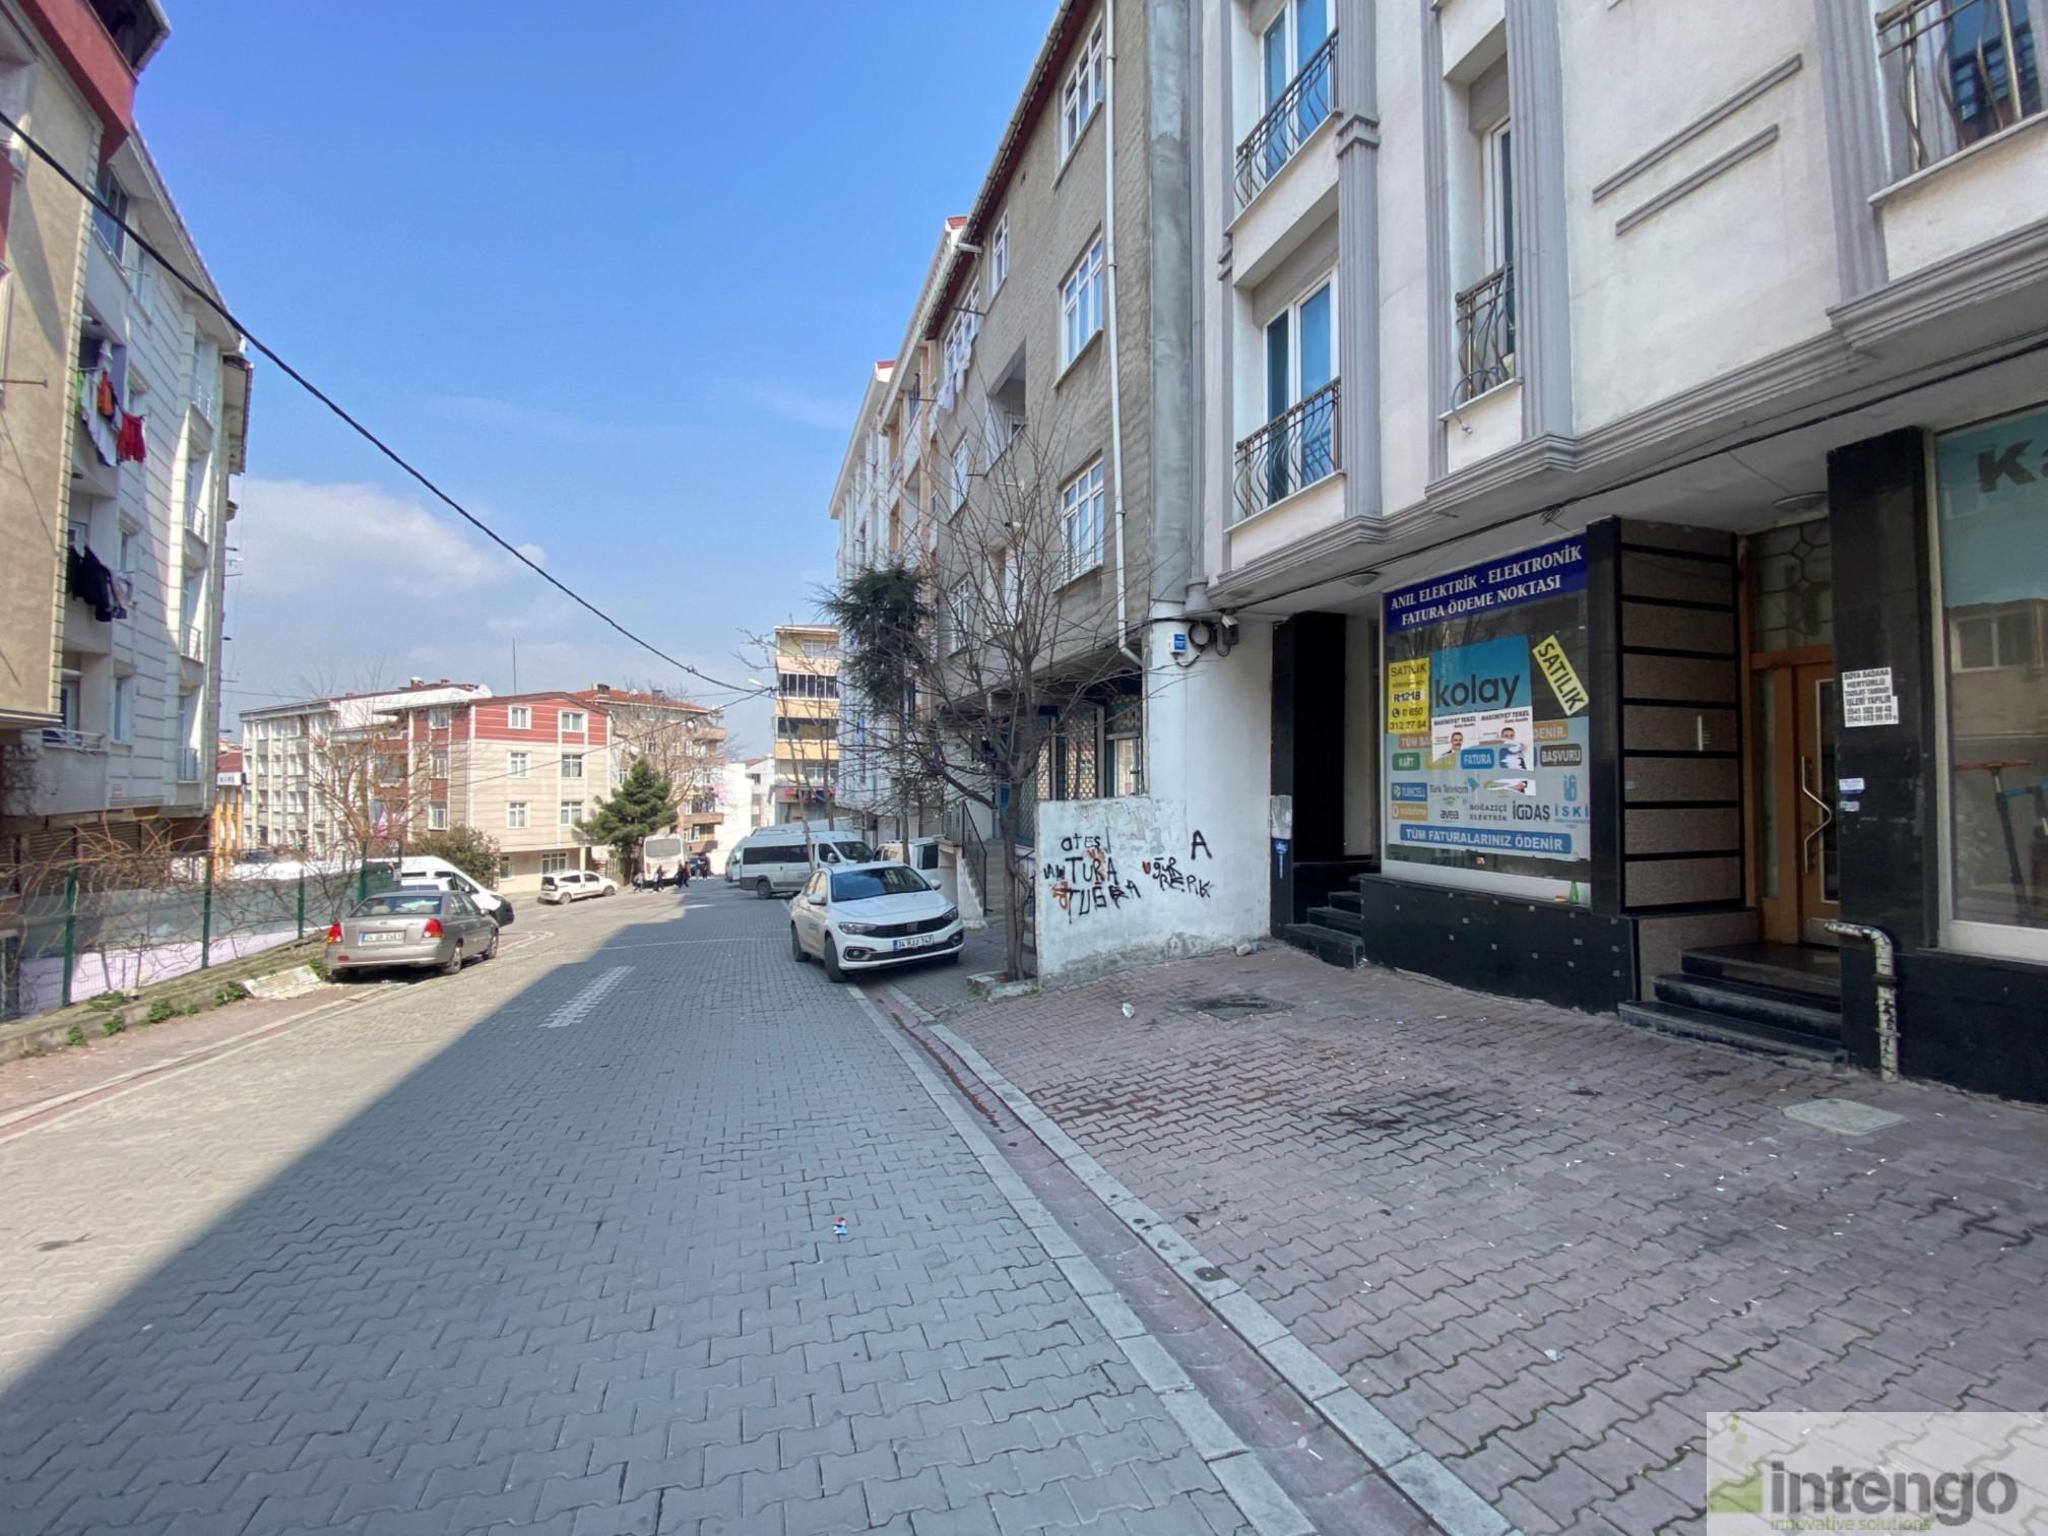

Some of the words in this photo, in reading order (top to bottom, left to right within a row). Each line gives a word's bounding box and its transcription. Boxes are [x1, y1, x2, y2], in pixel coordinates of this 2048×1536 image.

[1391, 595, 1417, 611] ANIL
[1418, 573, 1478, 602] ELEKTRİK
[1487, 544, 1582, 584] ELEKTRONİK
[1401, 604, 1445, 626] FATURA
[1447, 593, 1495, 615] ÖDEME
[1497, 574, 1561, 603] NOKTASI
[1538, 642, 1585, 713] SATILIK
[1434, 673, 1520, 708] kolay
[1398, 756, 1415, 768] KART
[1463, 752, 1492, 766] FATURA
[1541, 749, 1581, 764] BAŞVURU
[1440, 809, 1460, 820] avea
[1469, 802, 1507, 813] BOĞAZİÇİ
[1512, 800, 1551, 823] İGDAŞ
[1190, 829, 1213, 860] A
[1406, 828, 1427, 839] TÜM
[1428, 829, 1512, 848] FATURALARINIZ
[1514, 834, 1564, 850] ÖDENİR
